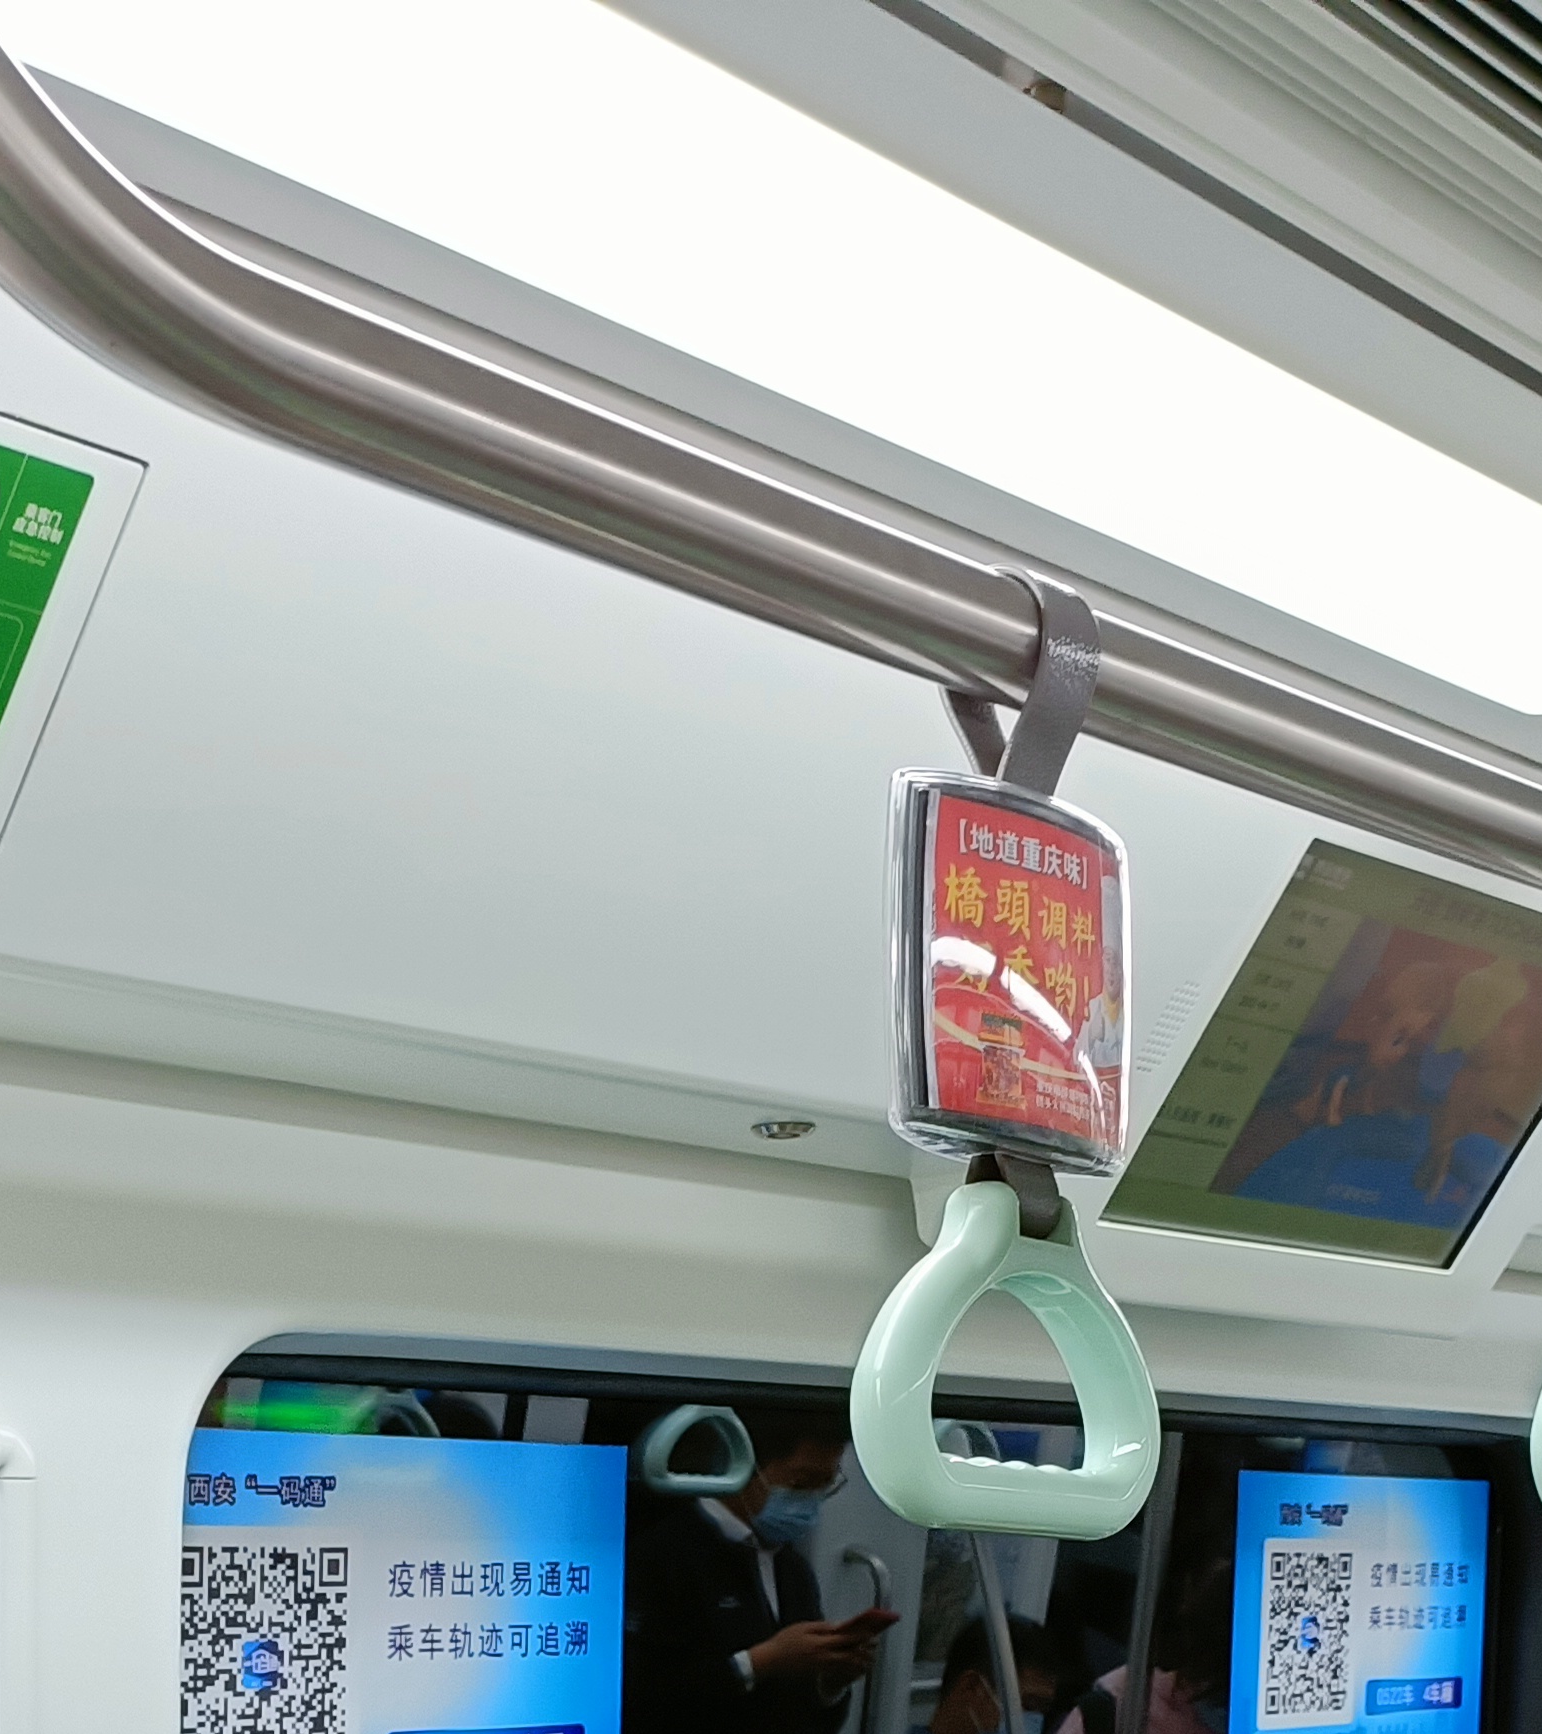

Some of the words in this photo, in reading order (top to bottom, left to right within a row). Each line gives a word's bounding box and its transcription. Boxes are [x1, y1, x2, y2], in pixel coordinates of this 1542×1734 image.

[188, 1473, 236, 1506] 西安
[388, 1560, 590, 1598] 疫情出现易通知
[387, 1620, 589, 1661] 乘车轨迹可追溯
